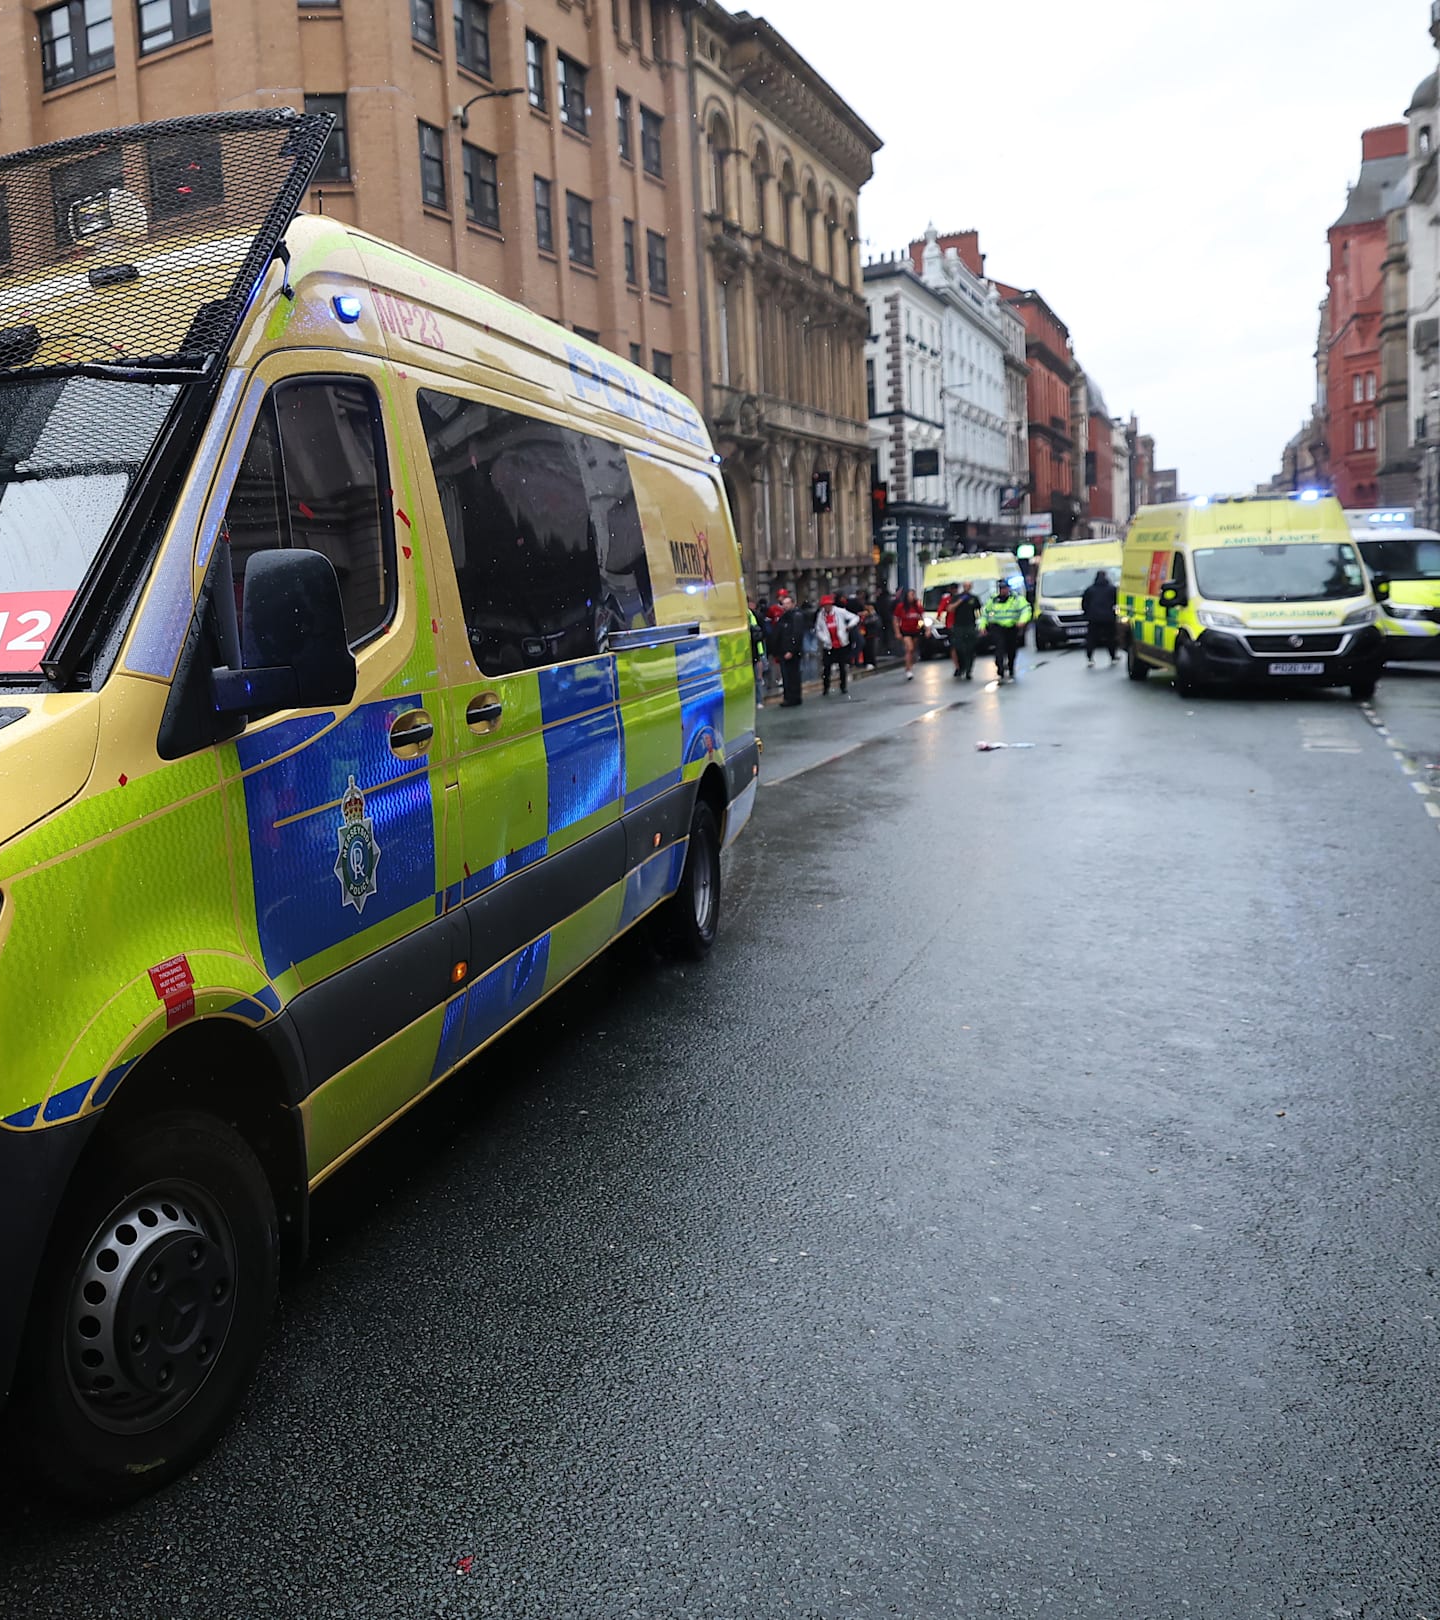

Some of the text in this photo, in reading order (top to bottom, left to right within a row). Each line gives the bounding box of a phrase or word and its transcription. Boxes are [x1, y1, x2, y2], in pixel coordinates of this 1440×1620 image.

[371, 288, 445, 350] MP23
[563, 342, 707, 448] POLICE
[343, 825, 372, 859] MERSEYSIDE
[349, 876, 370, 895] POLICE
